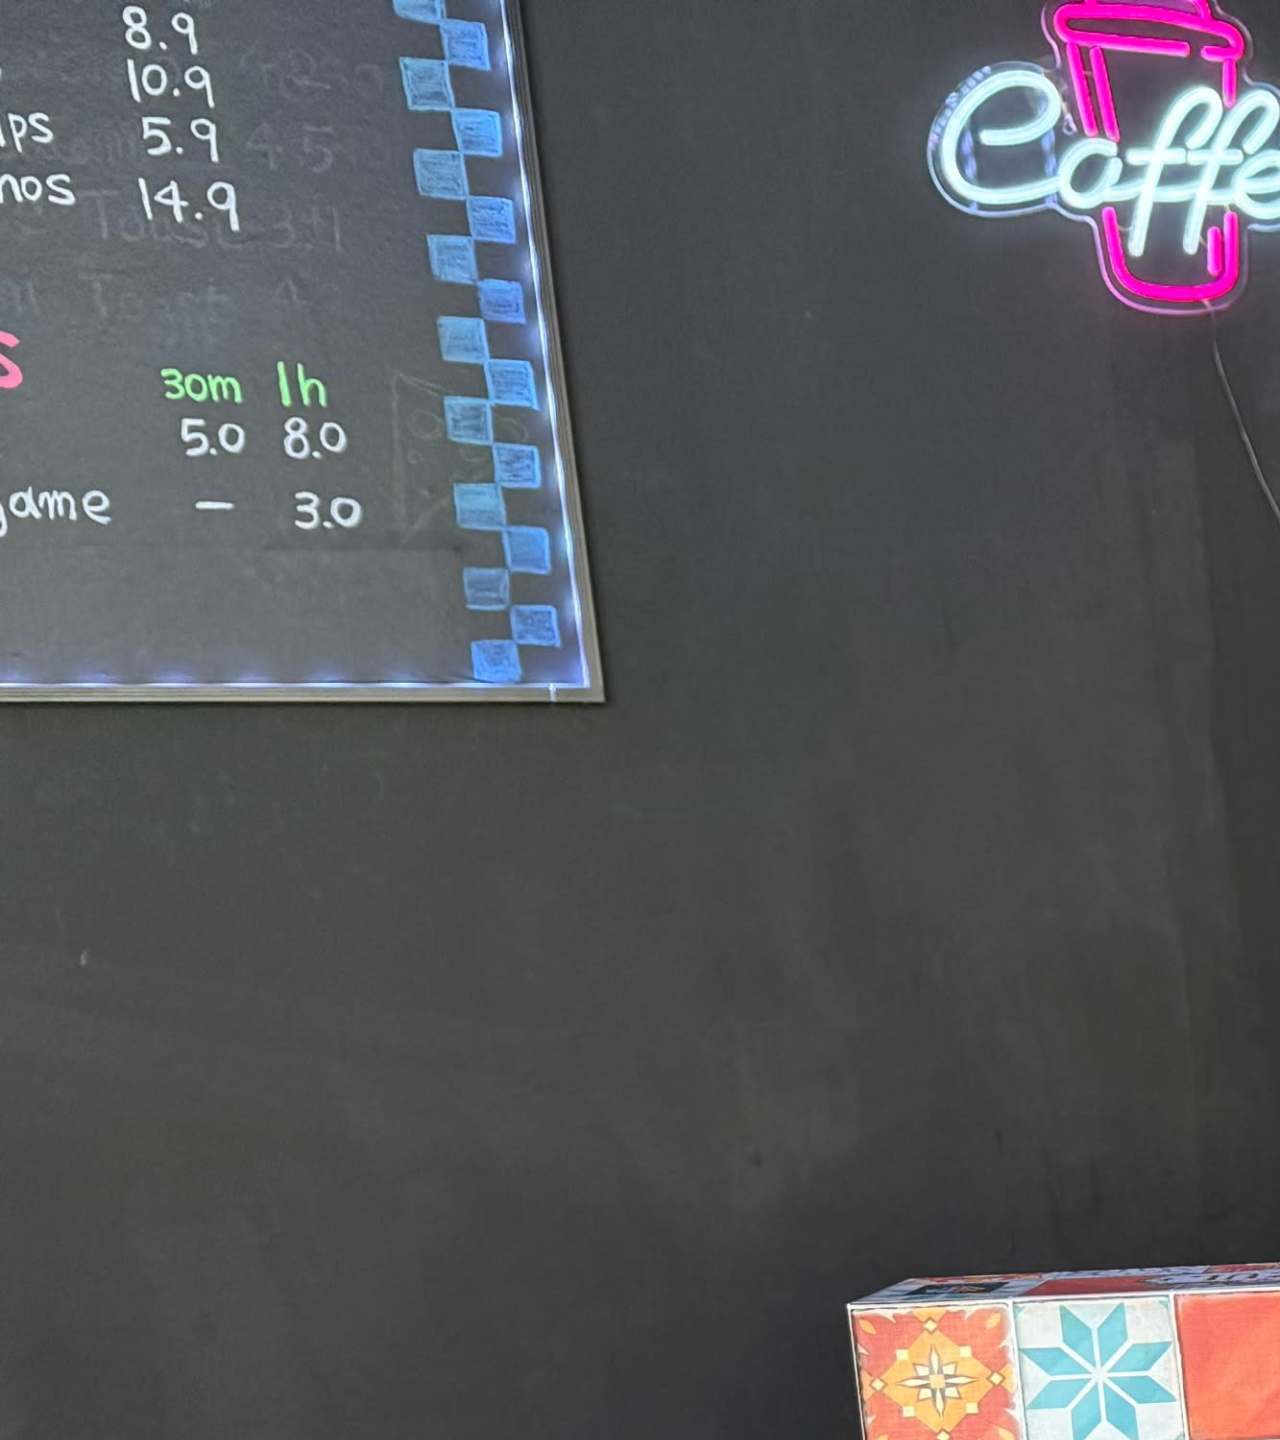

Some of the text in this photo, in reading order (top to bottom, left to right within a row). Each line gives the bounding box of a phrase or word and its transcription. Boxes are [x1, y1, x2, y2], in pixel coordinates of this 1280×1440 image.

[123, 6, 200, 55] 8.9
[127, 58, 215, 108] 10.9
[142, 116, 219, 163] 5.9
[138, 177, 240, 232] 14.9
[181, 417, 347, 461] 5.0 8.0
[295, 492, 361, 529] 3.0
